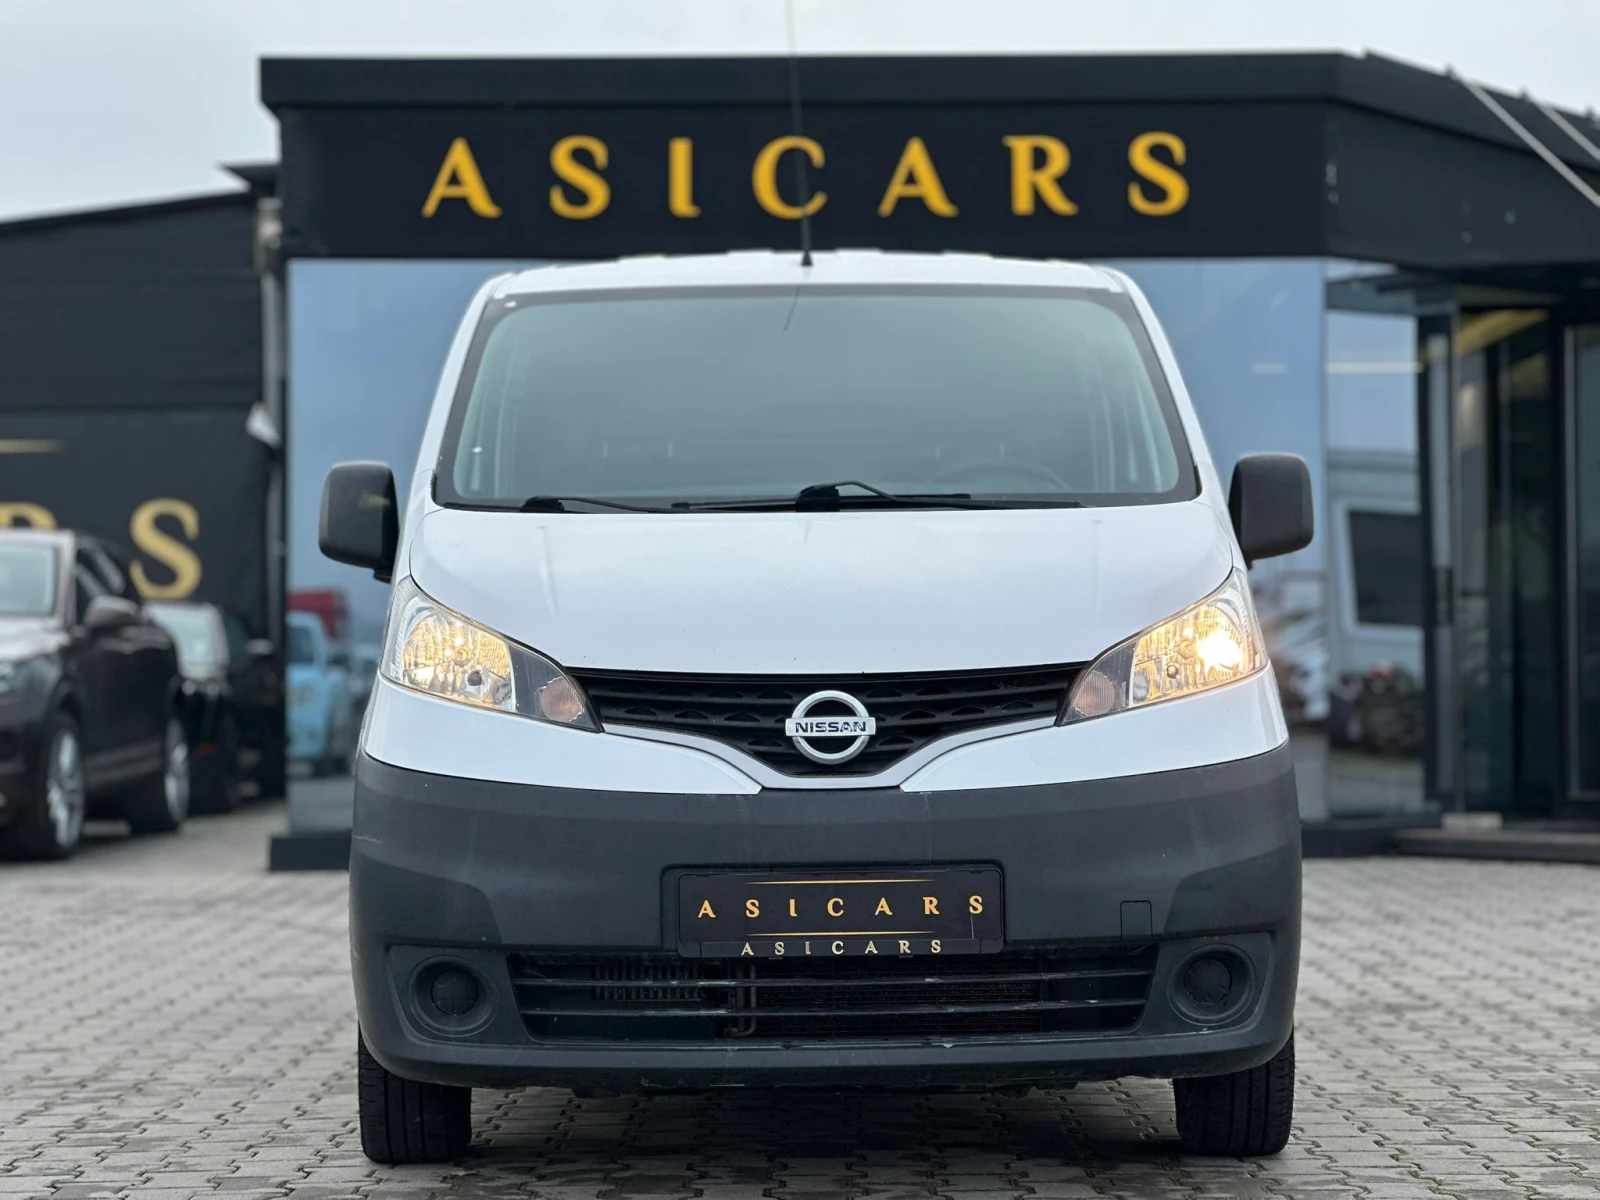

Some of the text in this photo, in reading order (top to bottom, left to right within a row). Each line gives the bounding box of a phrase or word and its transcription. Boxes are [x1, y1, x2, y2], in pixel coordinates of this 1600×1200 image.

[421, 131, 1190, 219] ASICARS
[795, 721, 867, 733] NISSAN
[697, 895, 984, 919] ASICARS
[740, 939, 943, 957] ASICARS
